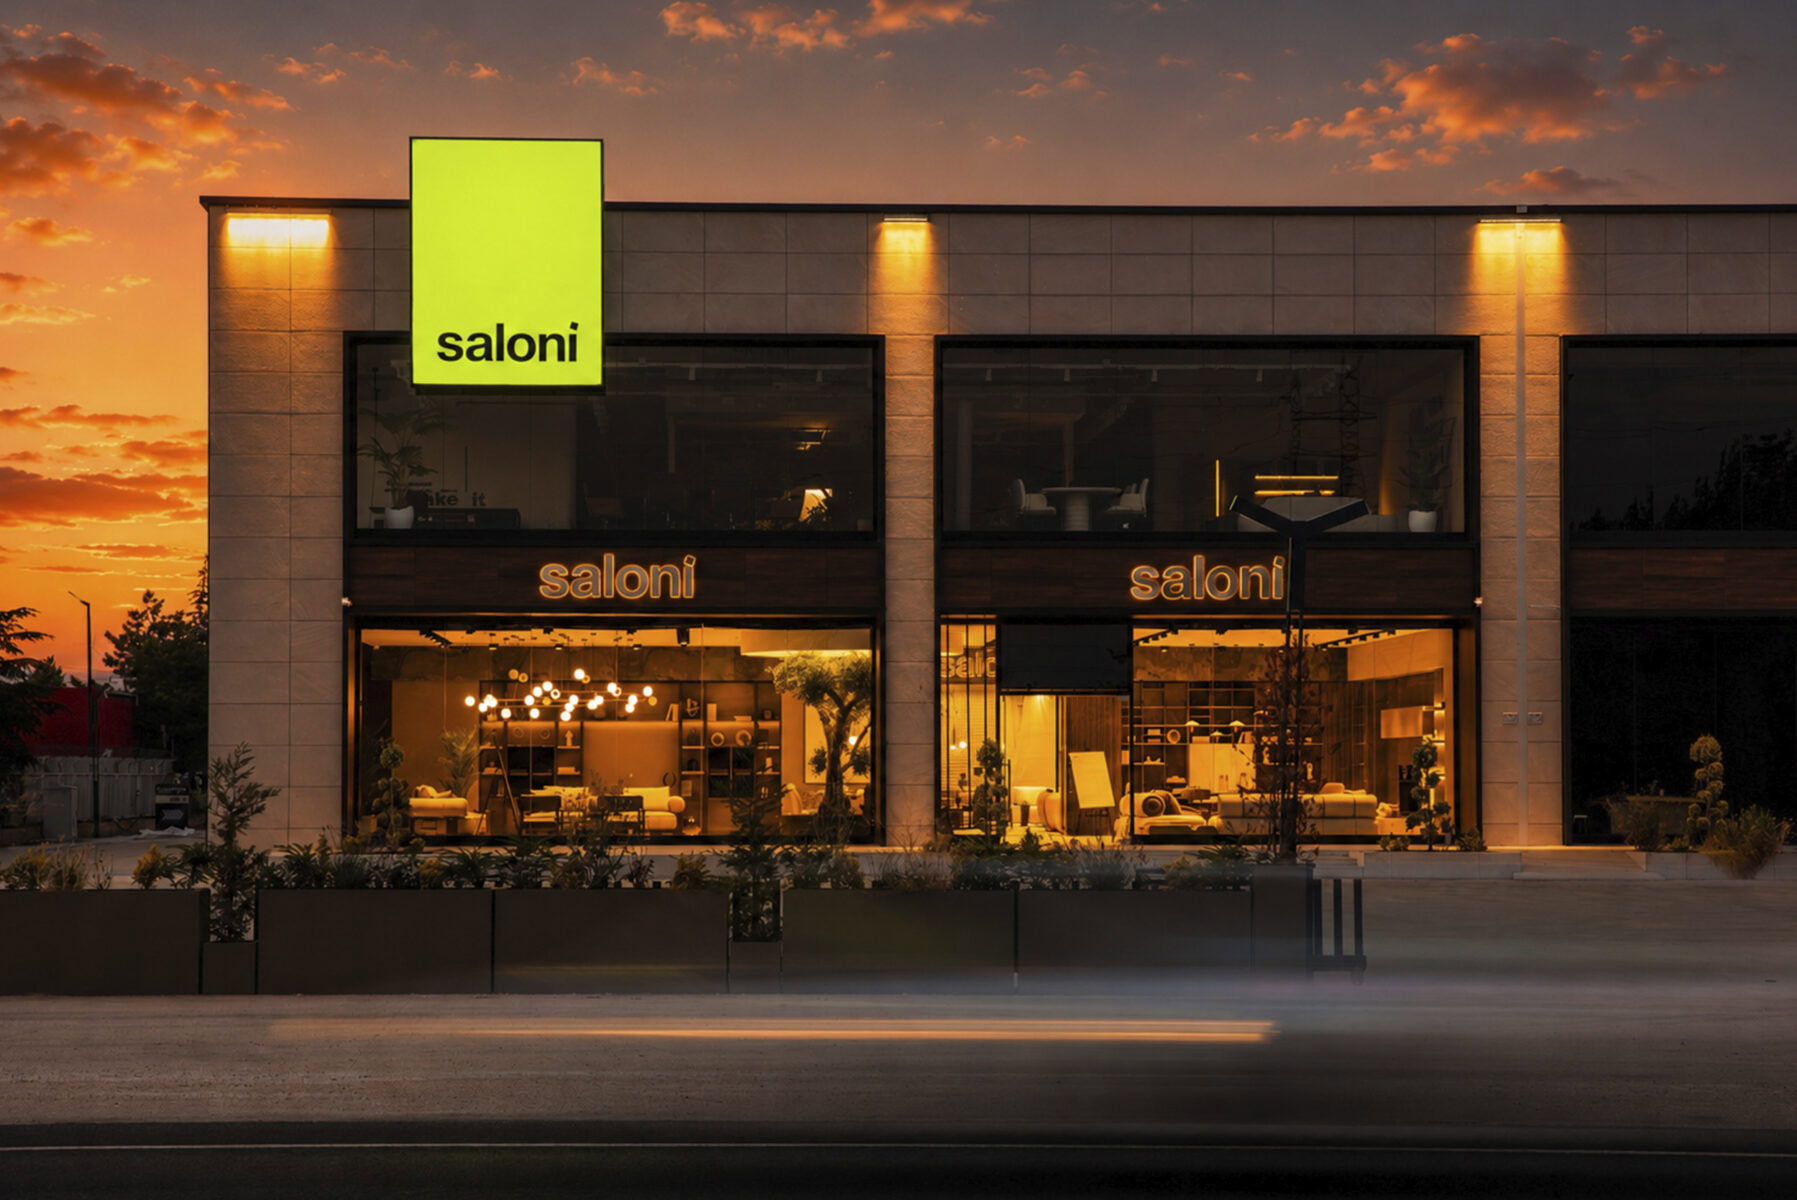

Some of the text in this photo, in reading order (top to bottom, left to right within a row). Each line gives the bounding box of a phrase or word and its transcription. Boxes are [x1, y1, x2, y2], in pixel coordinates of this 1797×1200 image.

[436, 321, 579, 362] saloni
[427, 491, 487, 506] ake it
[538, 553, 697, 600] saloni
[1129, 554, 1286, 601] saloni
